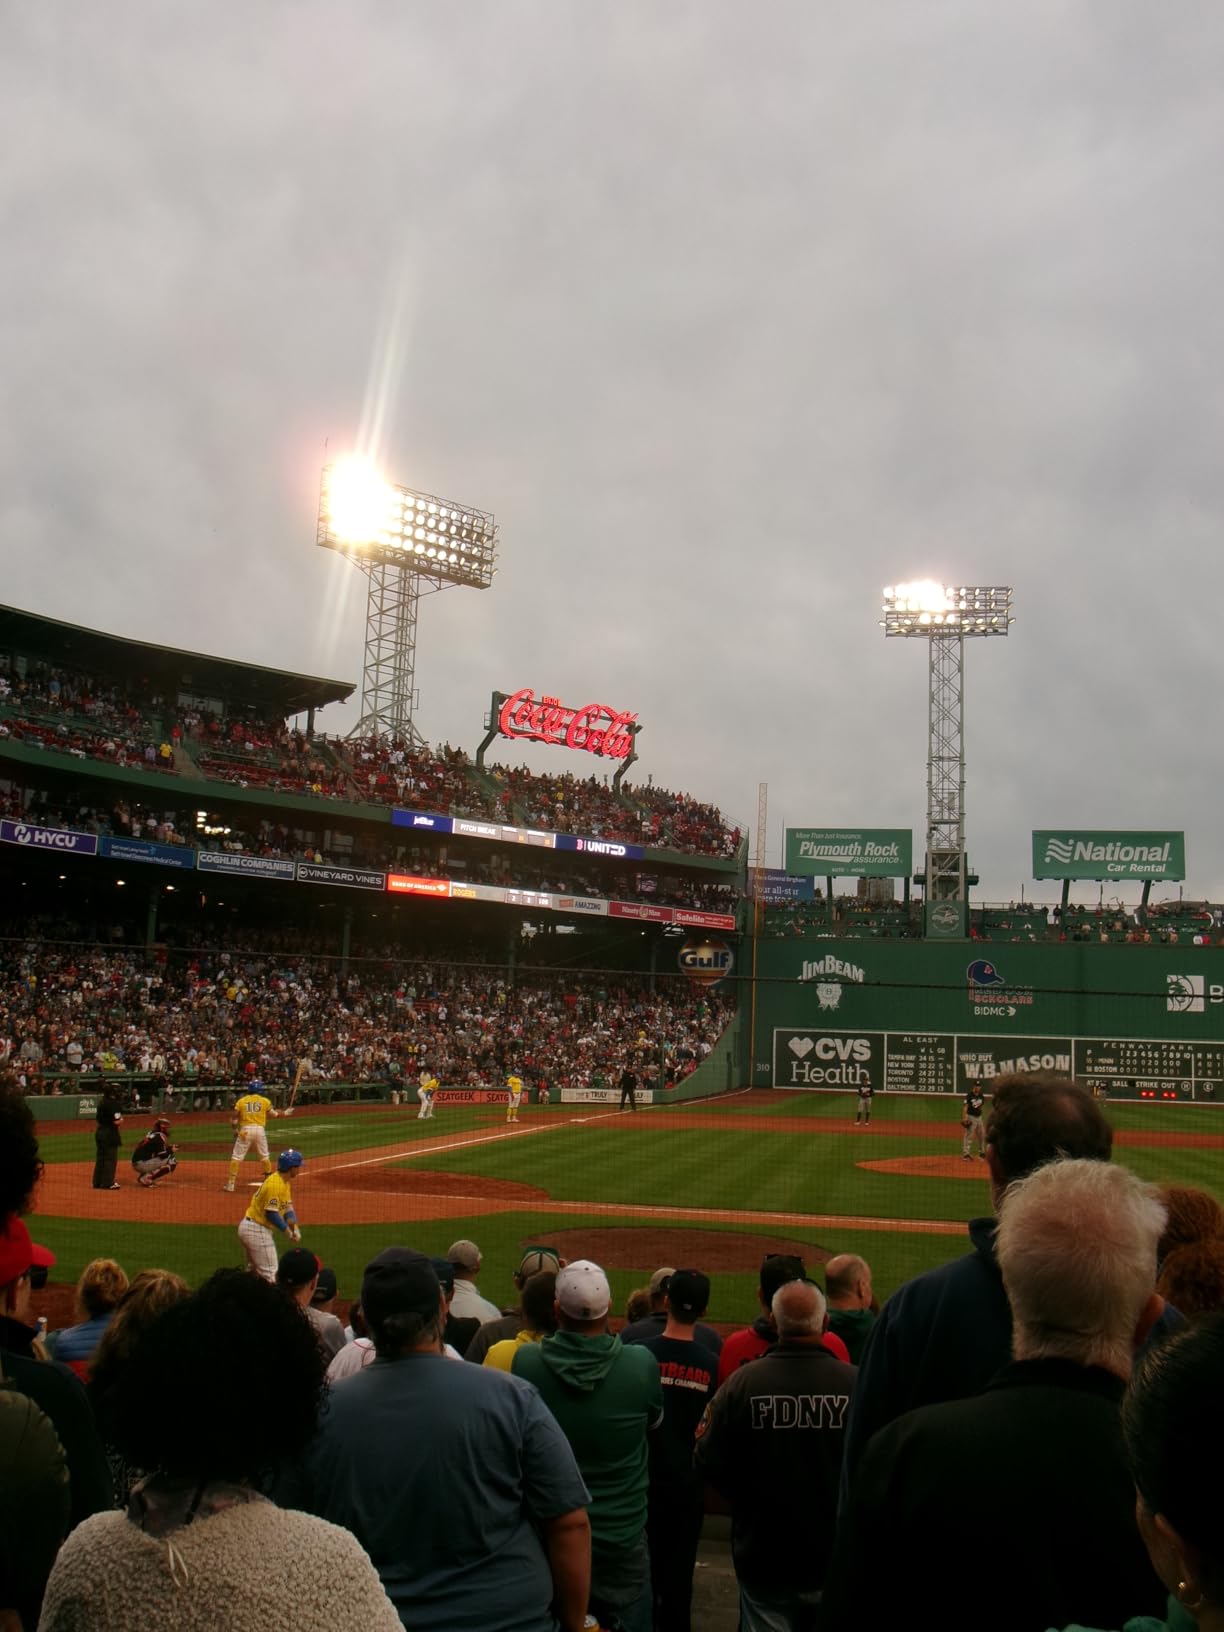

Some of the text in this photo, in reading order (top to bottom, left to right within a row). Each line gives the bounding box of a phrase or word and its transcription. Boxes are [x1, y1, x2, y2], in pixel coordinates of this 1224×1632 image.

[543, 697, 561, 706] ENJOY
[499, 688, 639, 758] Coca-Cola
[460, 824, 477, 832] PITCH
[34, 832, 77, 847] HYCU
[800, 842, 899, 857] Plymouth Rock
[1073, 841, 1170, 862] National
[200, 853, 240, 867] COGHLIN
[241, 859, 293, 872] COMPANIES
[853, 856, 899, 864] assurance
[1106, 863, 1166, 873] Car Rental
[308, 869, 382, 885] VINEYARD VINES
[676, 912, 705, 924] Safelite
[680, 951, 731, 968] Gulf
[796, 954, 865, 984] JIM BEAM
[974, 1006, 1006, 1016] BIDMC
[815, 1037, 871, 1061] CVS
[1103, 1042, 1153, 1050] FENWAY
[960, 1054, 993, 1062] WHO BUT
[756, 1063, 770, 1072] 310
[964, 1054, 1071, 1079] W.B. MASON
[790, 1061, 871, 1085] Health
[1136, 1081, 1158, 1089] STRIKE
[437, 1091, 475, 1101] SEATGEEK
[487, 1092, 510, 1102] SEATG
[591, 1091, 607, 1099] TRULY
[246, 1102, 261, 1113] 16
[657, 1360, 711, 1384] TBEARD
[660, 1376, 674, 1385] RIES
[750, 1395, 849, 1429] FDNY
